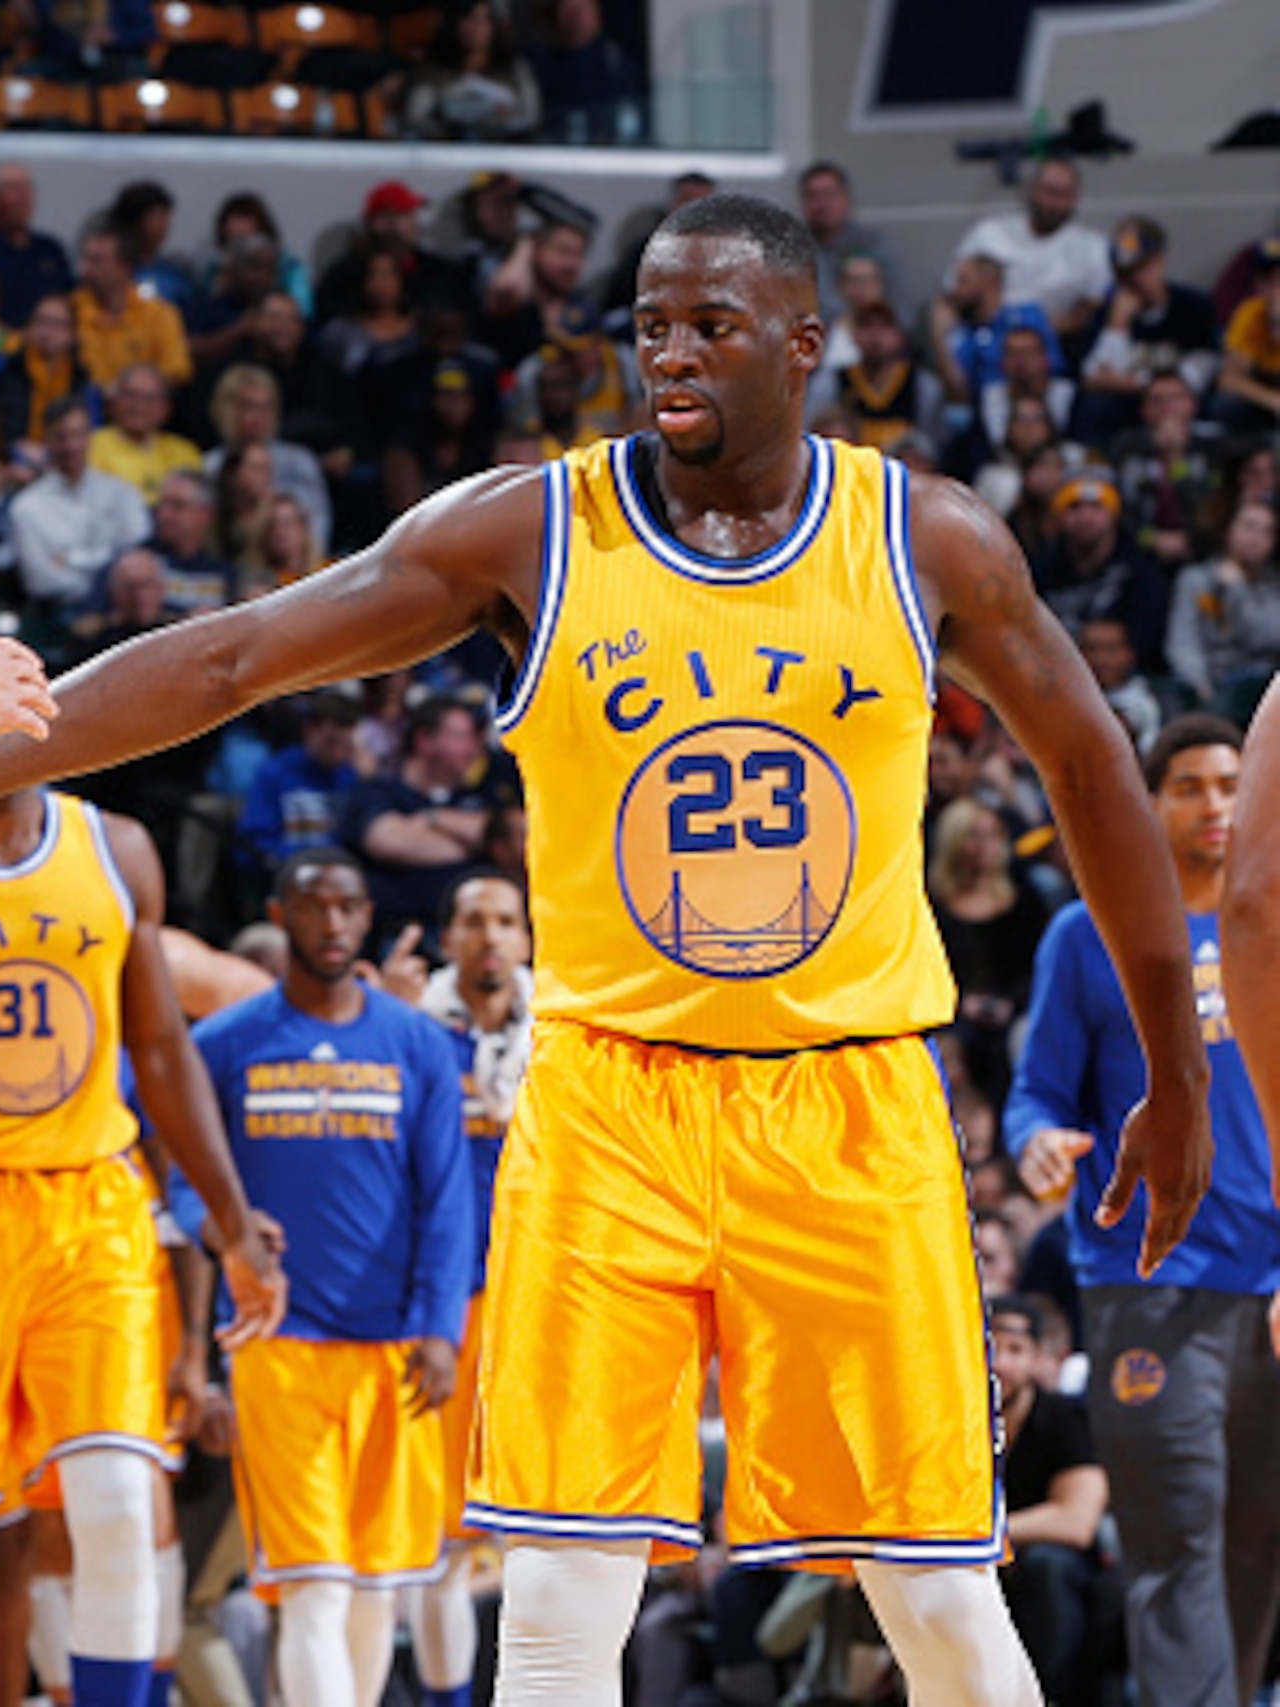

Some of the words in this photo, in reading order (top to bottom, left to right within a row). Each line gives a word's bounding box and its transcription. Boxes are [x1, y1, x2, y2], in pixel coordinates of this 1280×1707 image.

[576, 628, 648, 681] The
[603, 646, 884, 733] CITY
[664, 750, 809, 854] 23
[245, 1060, 402, 1093] WARRIORS
[245, 1112, 397, 1141] BASKETBALL
